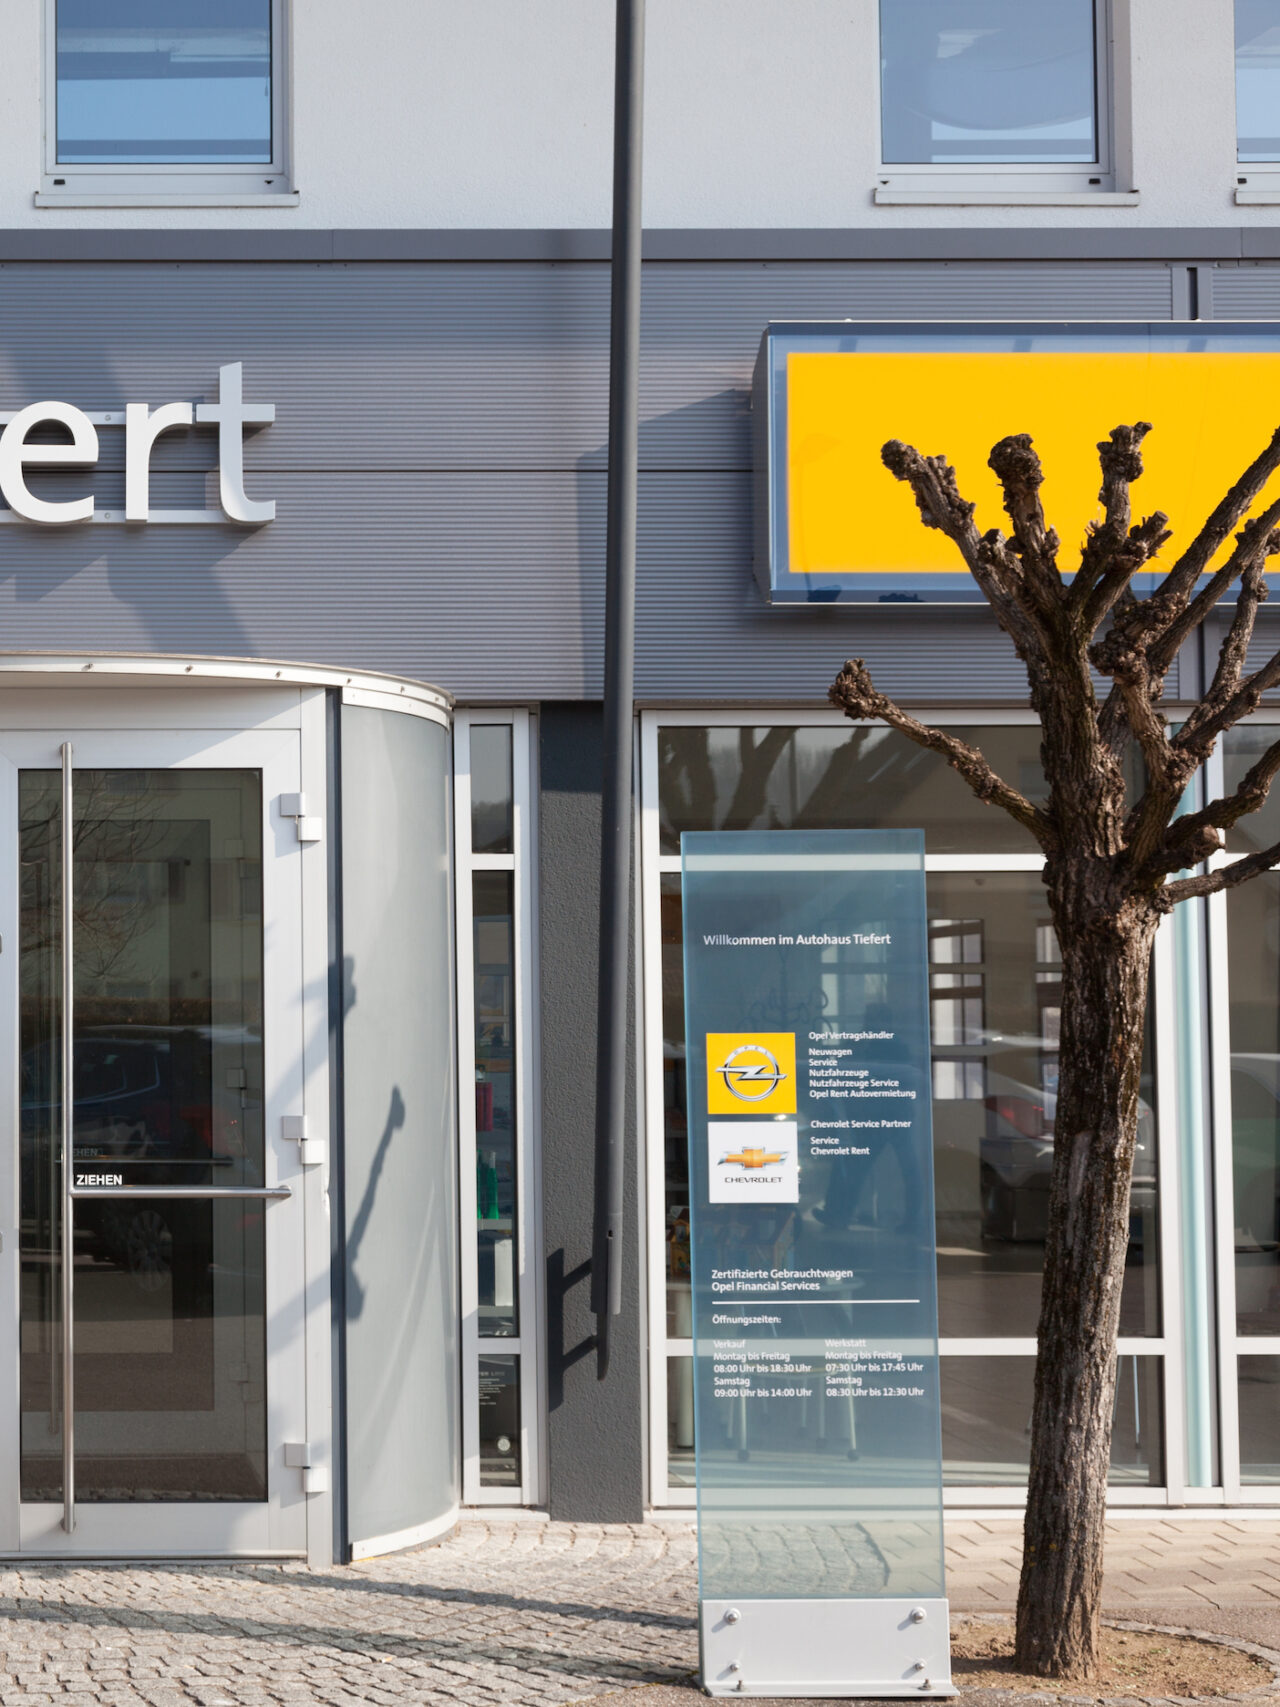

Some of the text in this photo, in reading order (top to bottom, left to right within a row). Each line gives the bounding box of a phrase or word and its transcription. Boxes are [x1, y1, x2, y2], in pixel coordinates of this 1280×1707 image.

[704, 933, 891, 945] Willkommen im Autohaus Tiefert
[808, 1031, 894, 1042] Opel Vertragshändler
[808, 1048, 852, 1058] Neuwagen
[808, 1058, 838, 1066] Service
[809, 1068, 869, 1078] Nutzfahrzeuge
[809, 1079, 900, 1089] Nutzfahrzeuge Service
[809, 1090, 916, 1099] Opel Rent Autovermietung
[811, 1120, 912, 1128] Chevrolet Service Partner
[810, 1136, 839, 1144] Service
[811, 1147, 870, 1155] Chevrolet Rent
[76, 1174, 122, 1186] ZIEHEN
[711, 1269, 853, 1280] Zertifizierte Gebrauchtwagen
[711, 1281, 820, 1293] Opel Financial Services
[712, 1314, 781, 1326] Öffnungszeiten:
[713, 1340, 746, 1349] Verkauf
[825, 1339, 867, 1348] Werkstatt
[713, 1352, 790, 1363] Montag bis Freitag
[825, 1351, 902, 1362] Montag bis Freitag
[713, 1364, 812, 1373] 08:00 Uhr bis 18:30 Uhr
[825, 1363, 924, 1372] 07:30 Uhr bis 17:45 Uhr
[714, 1377, 750, 1387] Samstag
[825, 1376, 862, 1386] Samstag
[714, 1388, 812, 1397] 09:00 Uhr bis 14:00 Uhr
[826, 1388, 924, 1397] 08:30 Uhr bis 12:30 Uhr
